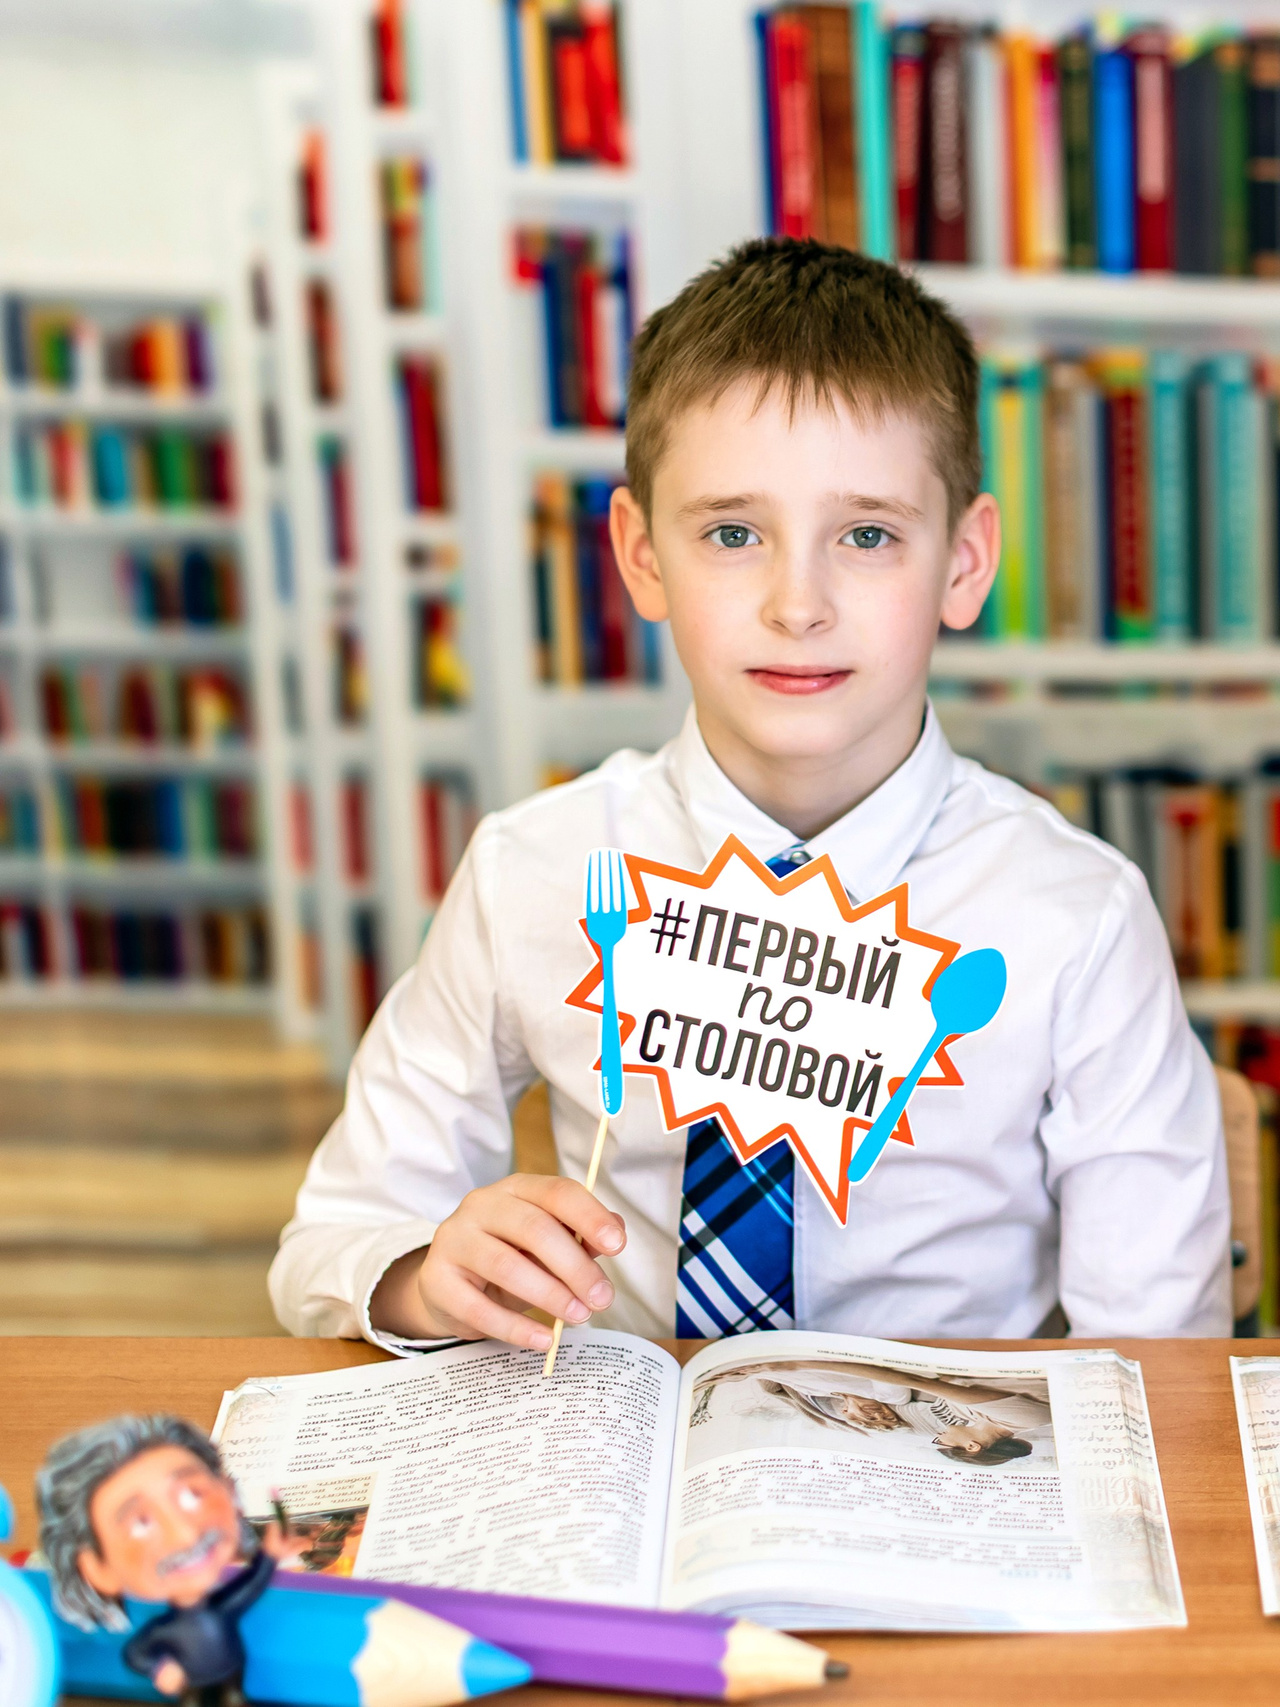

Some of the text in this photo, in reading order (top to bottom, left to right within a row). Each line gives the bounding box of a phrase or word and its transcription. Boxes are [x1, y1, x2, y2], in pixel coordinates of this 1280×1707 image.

[649, 898, 901, 1009] #ПЕРВЫЙ
[738, 982, 813, 1032] по
[639, 1009, 884, 1117] СТОЛОВОЙ
